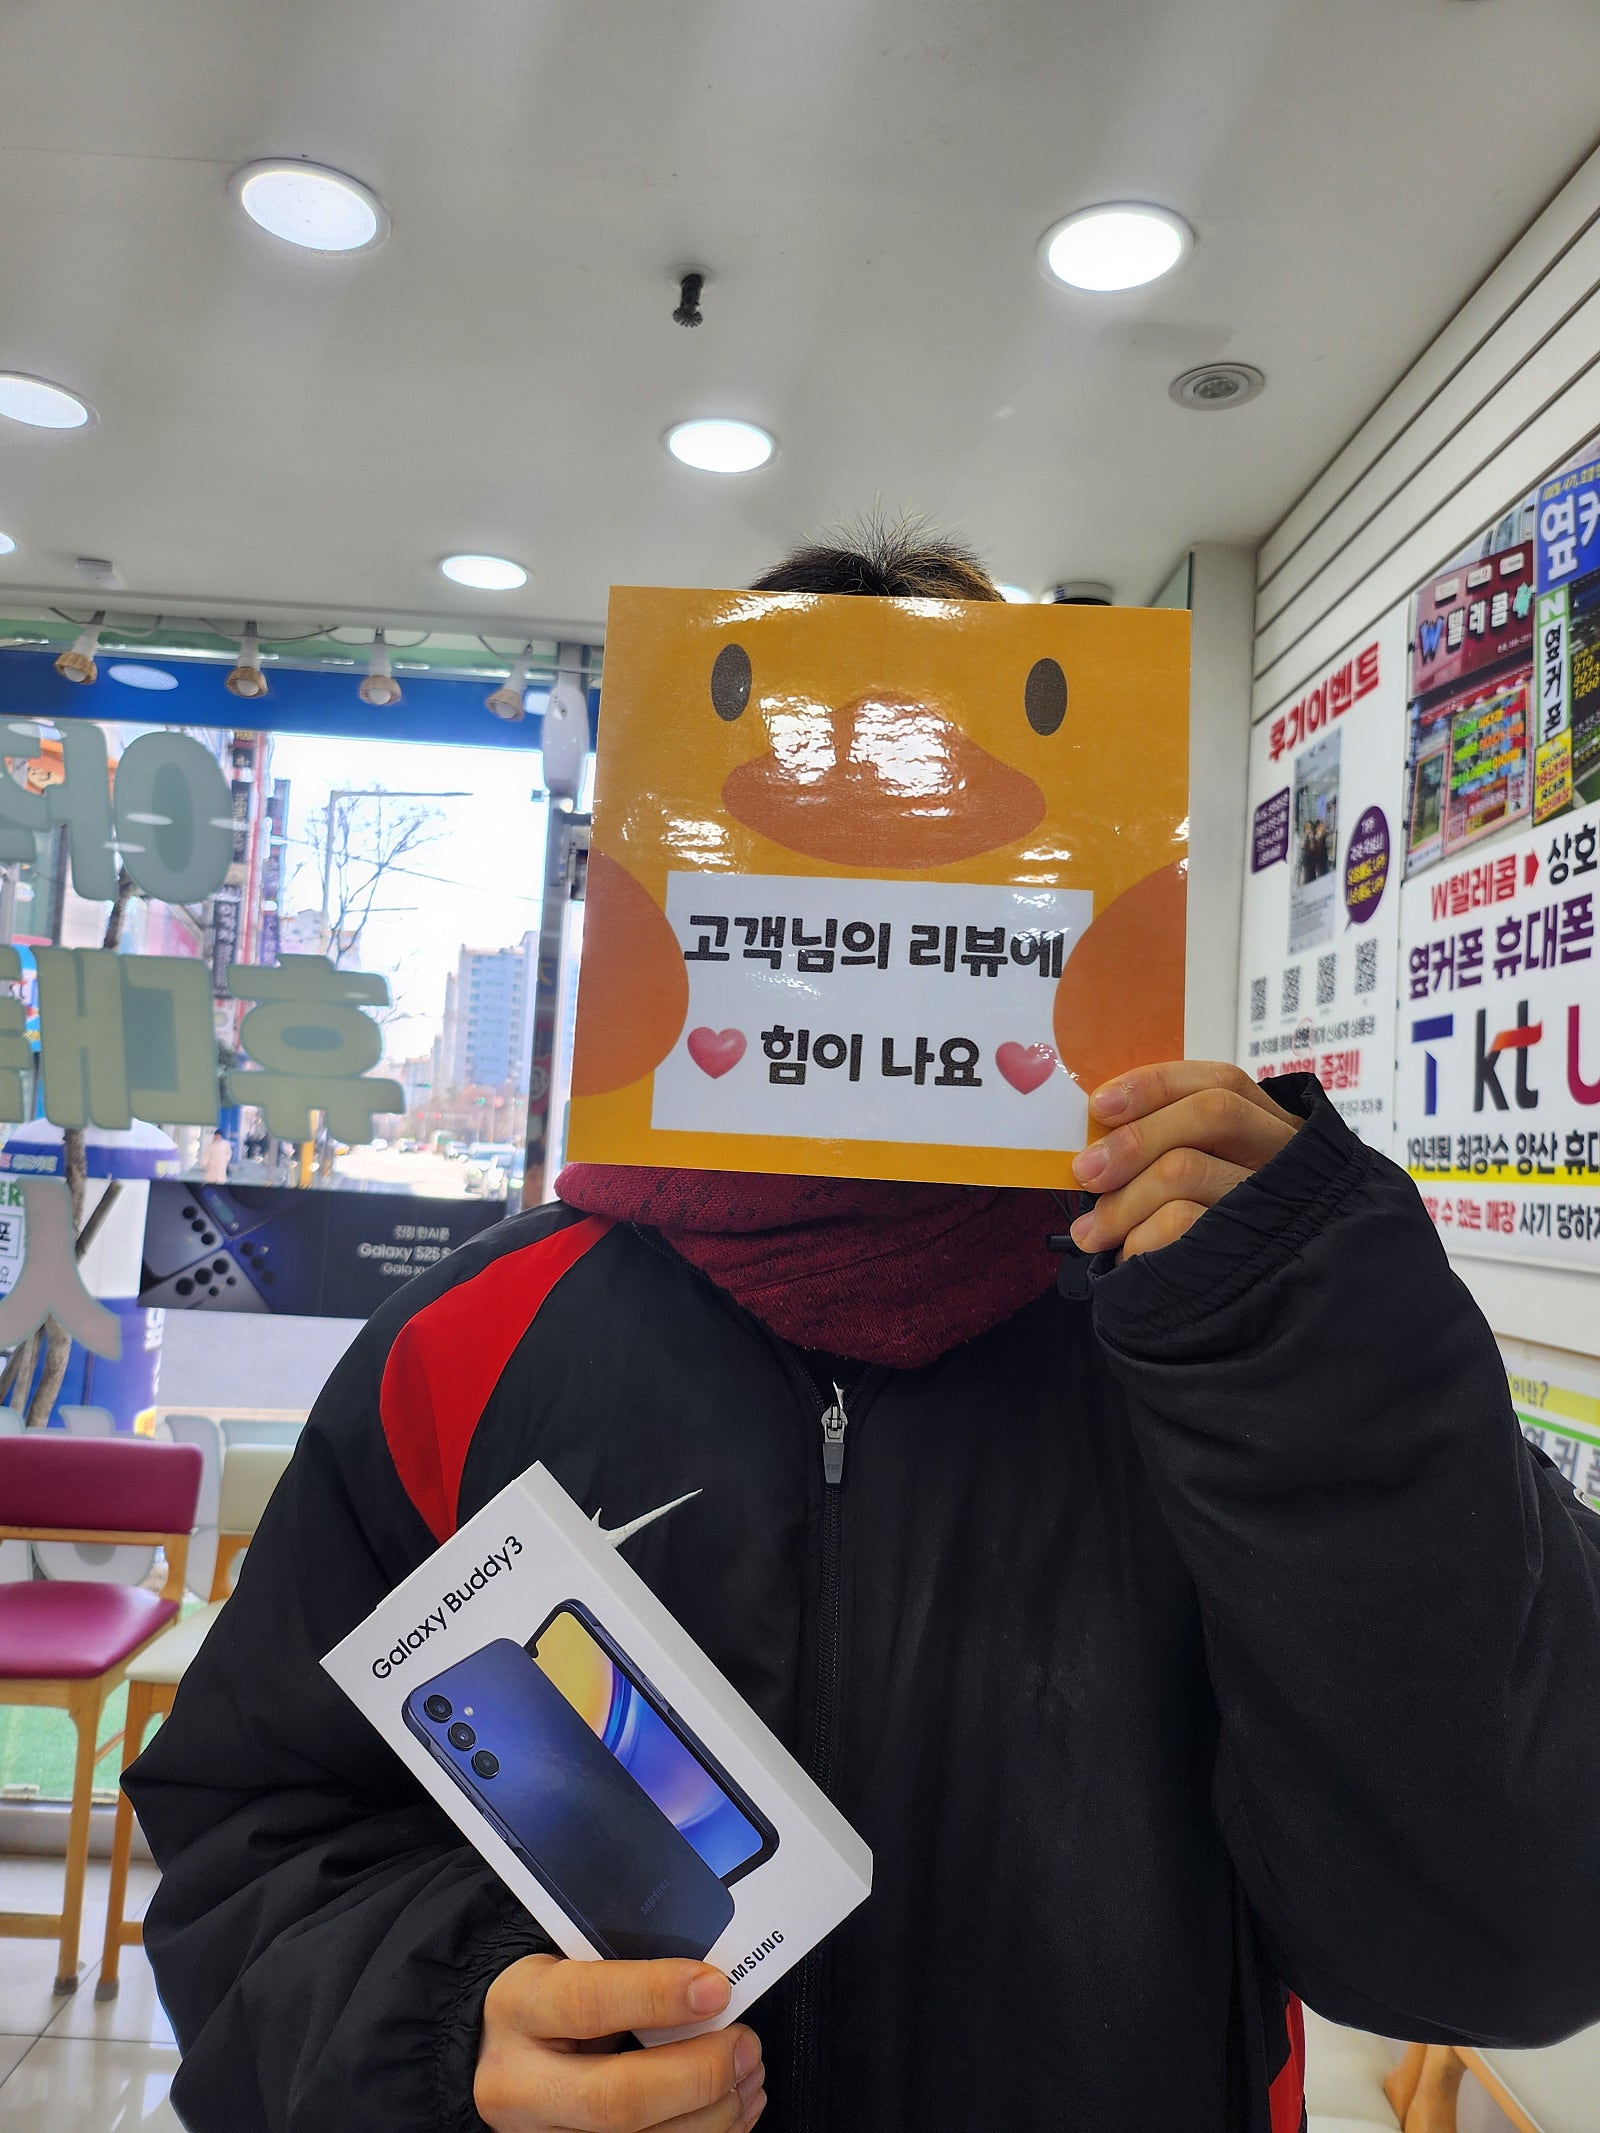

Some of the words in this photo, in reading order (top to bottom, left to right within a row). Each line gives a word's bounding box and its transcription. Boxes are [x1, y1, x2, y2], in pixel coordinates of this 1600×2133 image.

[1269, 642, 1380, 762] 후기이벤트
[1431, 854, 1517, 922] W텔레콤
[684, 914, 892, 974] 고객님의
[908, 923, 1065, 979] 리뷰에
[1409, 927, 1484, 1000] 옆커폰
[1493, 893, 1595, 981] 휴대폰
[760, 1024, 864, 1086] 힘이
[880, 1036, 984, 1087] 나요
[1411, 1013, 1454, 1116] T
[1473, 999, 1543, 1113] kt
[1456, 1133, 1509, 1175] 최장수
[1516, 1131, 1558, 1176] 양산
[1519, 1202, 1552, 1238] 사기
[358, 1242, 413, 1263] Galaxy
[415, 1245, 440, 1261] S25
[1511, 1378, 1549, 1409] 이란?
[371, 1606, 448, 1680] Galaxy
[442, 1535, 523, 1614] Buddy3
[726, 1929, 785, 1986] MSUNG
